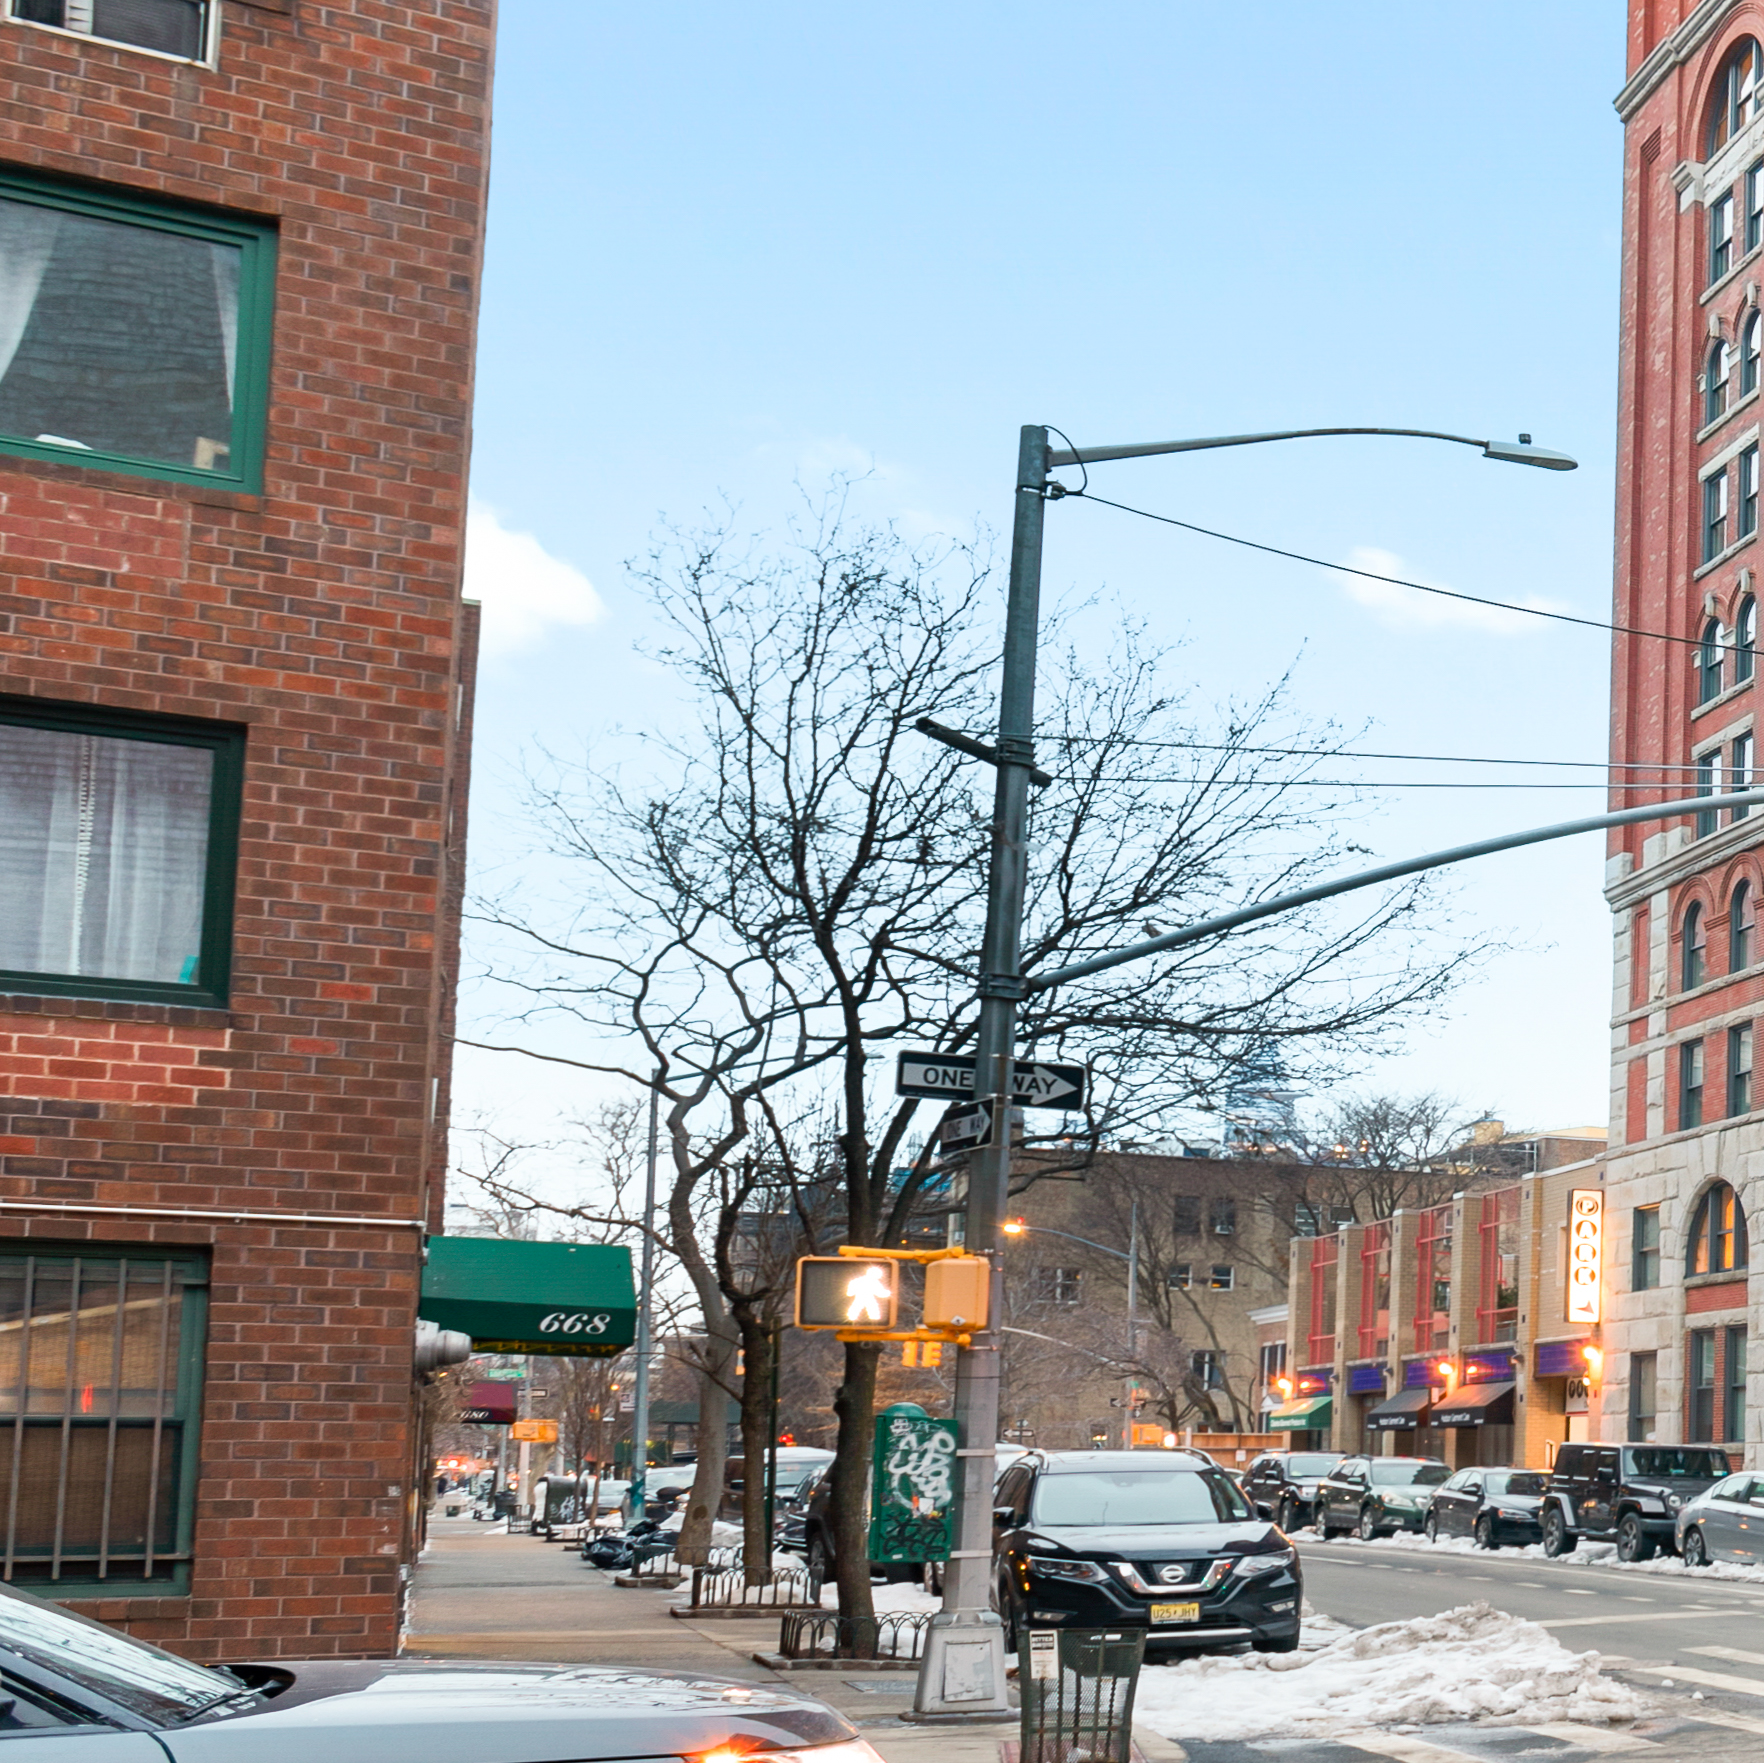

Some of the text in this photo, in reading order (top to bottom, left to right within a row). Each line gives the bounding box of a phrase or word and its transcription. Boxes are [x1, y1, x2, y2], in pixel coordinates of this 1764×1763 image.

[923, 1067, 974, 1087] ONE
[970, 1116, 985, 1134] WAY
[1575, 1197, 1598, 1285] PARK
[539, 1312, 611, 1335] 668
[1152, 1607, 1196, 1619] U25 JHY
